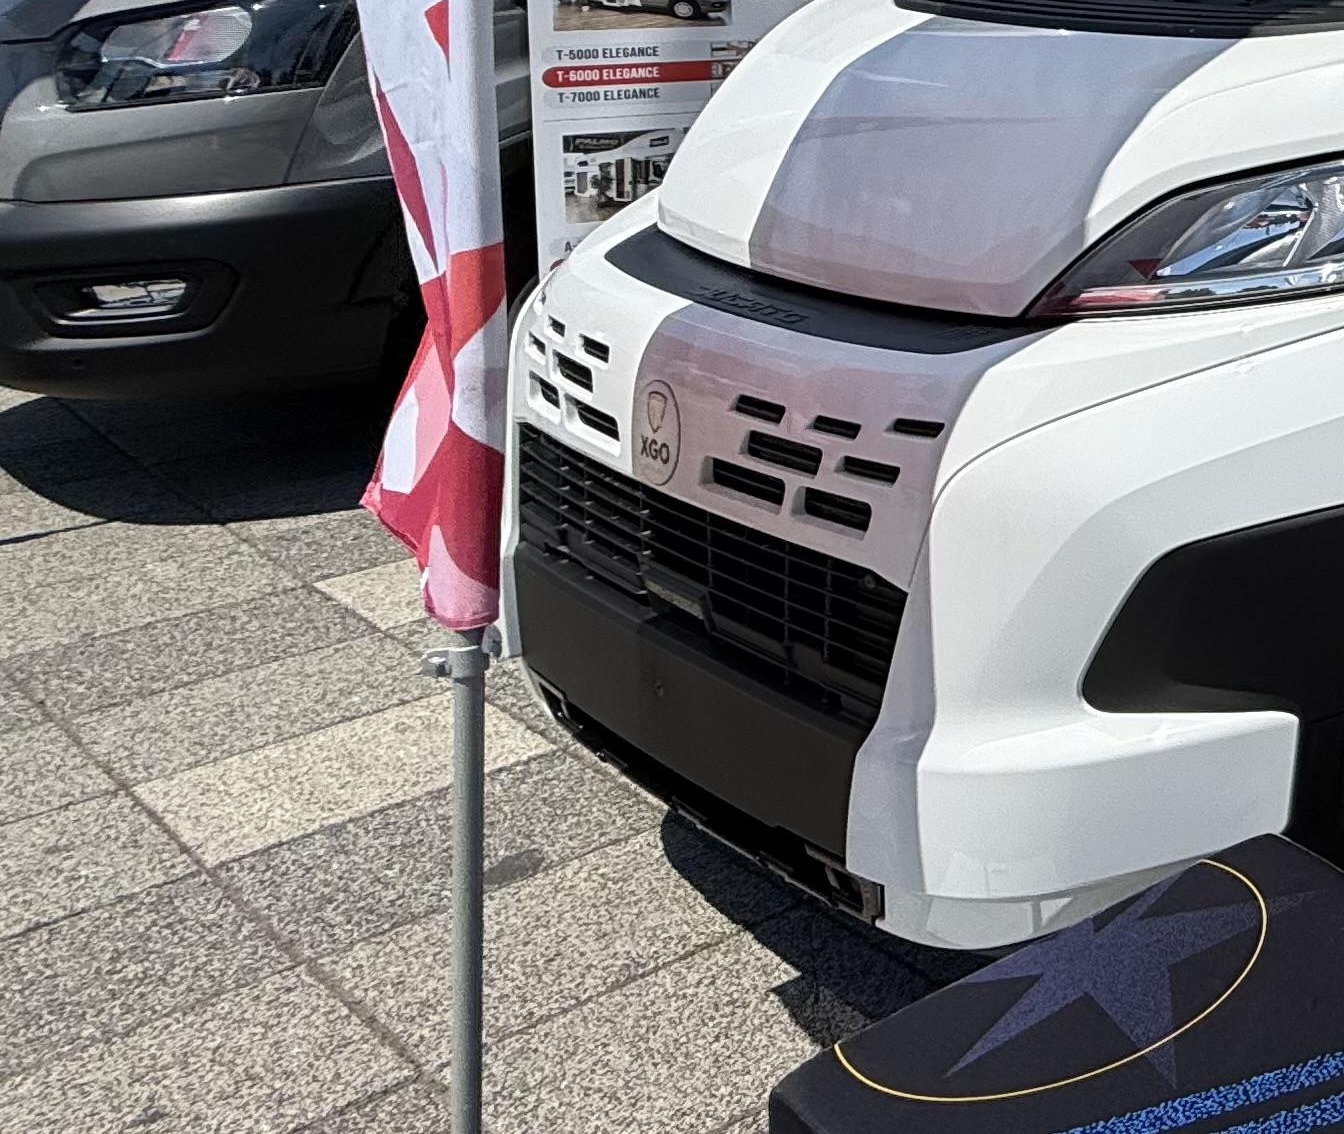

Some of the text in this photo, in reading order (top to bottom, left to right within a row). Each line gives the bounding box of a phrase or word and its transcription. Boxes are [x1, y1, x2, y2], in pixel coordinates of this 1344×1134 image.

[556, 46, 660, 61] T-5000 ELEGANCE
[556, 67, 660, 83] T-6000 ELEGANCE
[557, 88, 660, 103] T-7000 ELEGANCE
[639, 433, 671, 465] XGO
